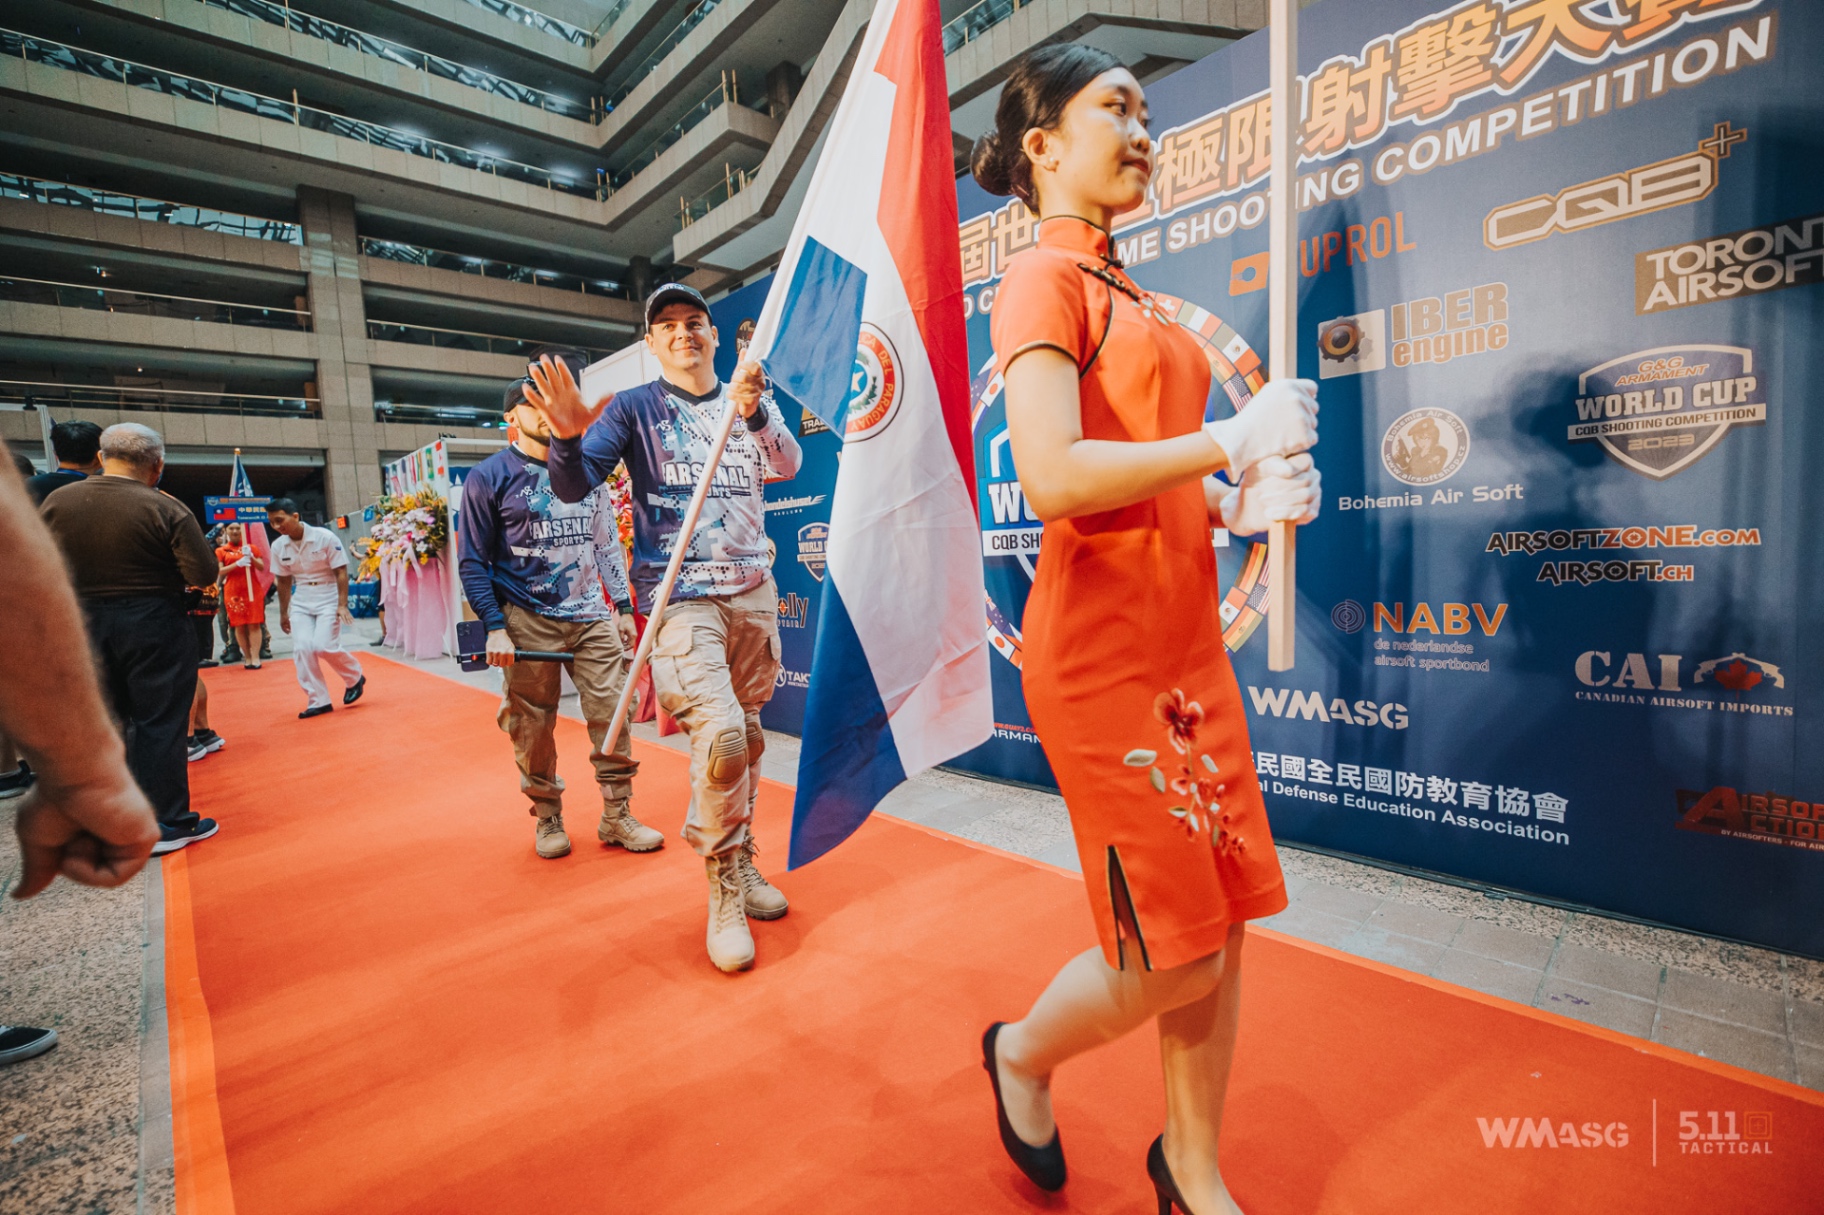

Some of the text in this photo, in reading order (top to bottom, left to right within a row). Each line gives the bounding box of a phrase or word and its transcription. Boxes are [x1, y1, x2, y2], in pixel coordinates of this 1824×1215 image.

[1169, 162, 1360, 250] SHOONG
[1376, 16, 1771, 181] COMPETITION
[1391, 282, 1509, 342] IBER
[1392, 322, 1509, 368] engine
[1614, 363, 1710, 388] ARMAMENT
[1637, 355, 1685, 374] G&G
[1575, 376, 1757, 421] WORLD CUP
[1386, 408, 1464, 443] Bohemia Air Soft
[1575, 407, 1757, 437] CQB SHOOTING COMPETITION
[1627, 433, 1696, 451] 2023
[664, 461, 750, 489] ARSNAL
[1384, 445, 1467, 484] www.airsoftshop.cz
[1338, 483, 1524, 511] Bohemia Air Soft
[553, 536, 586, 548] SPORTS
[992, 533, 1019, 551] CQB
[1485, 524, 1762, 557] AIRSOFTZONE.COM
[1536, 559, 1694, 587] AIRSOFT.CH
[1373, 602, 1509, 637] NABV
[1373, 637, 1475, 655] de nederlandse
[1373, 653, 1490, 673] airsoft sportbond
[1574, 650, 1683, 692] CAI
[1247, 686, 1409, 730] WMASG
[1575, 690, 1795, 717] CANADIAN AIRSOFT IMPORTS
[1250, 751, 1569, 824] 民國全民國防教育協會
[1273, 782, 1338, 805] Defense
[1343, 793, 1436, 822] Education
[1441, 811, 1570, 846] Association
